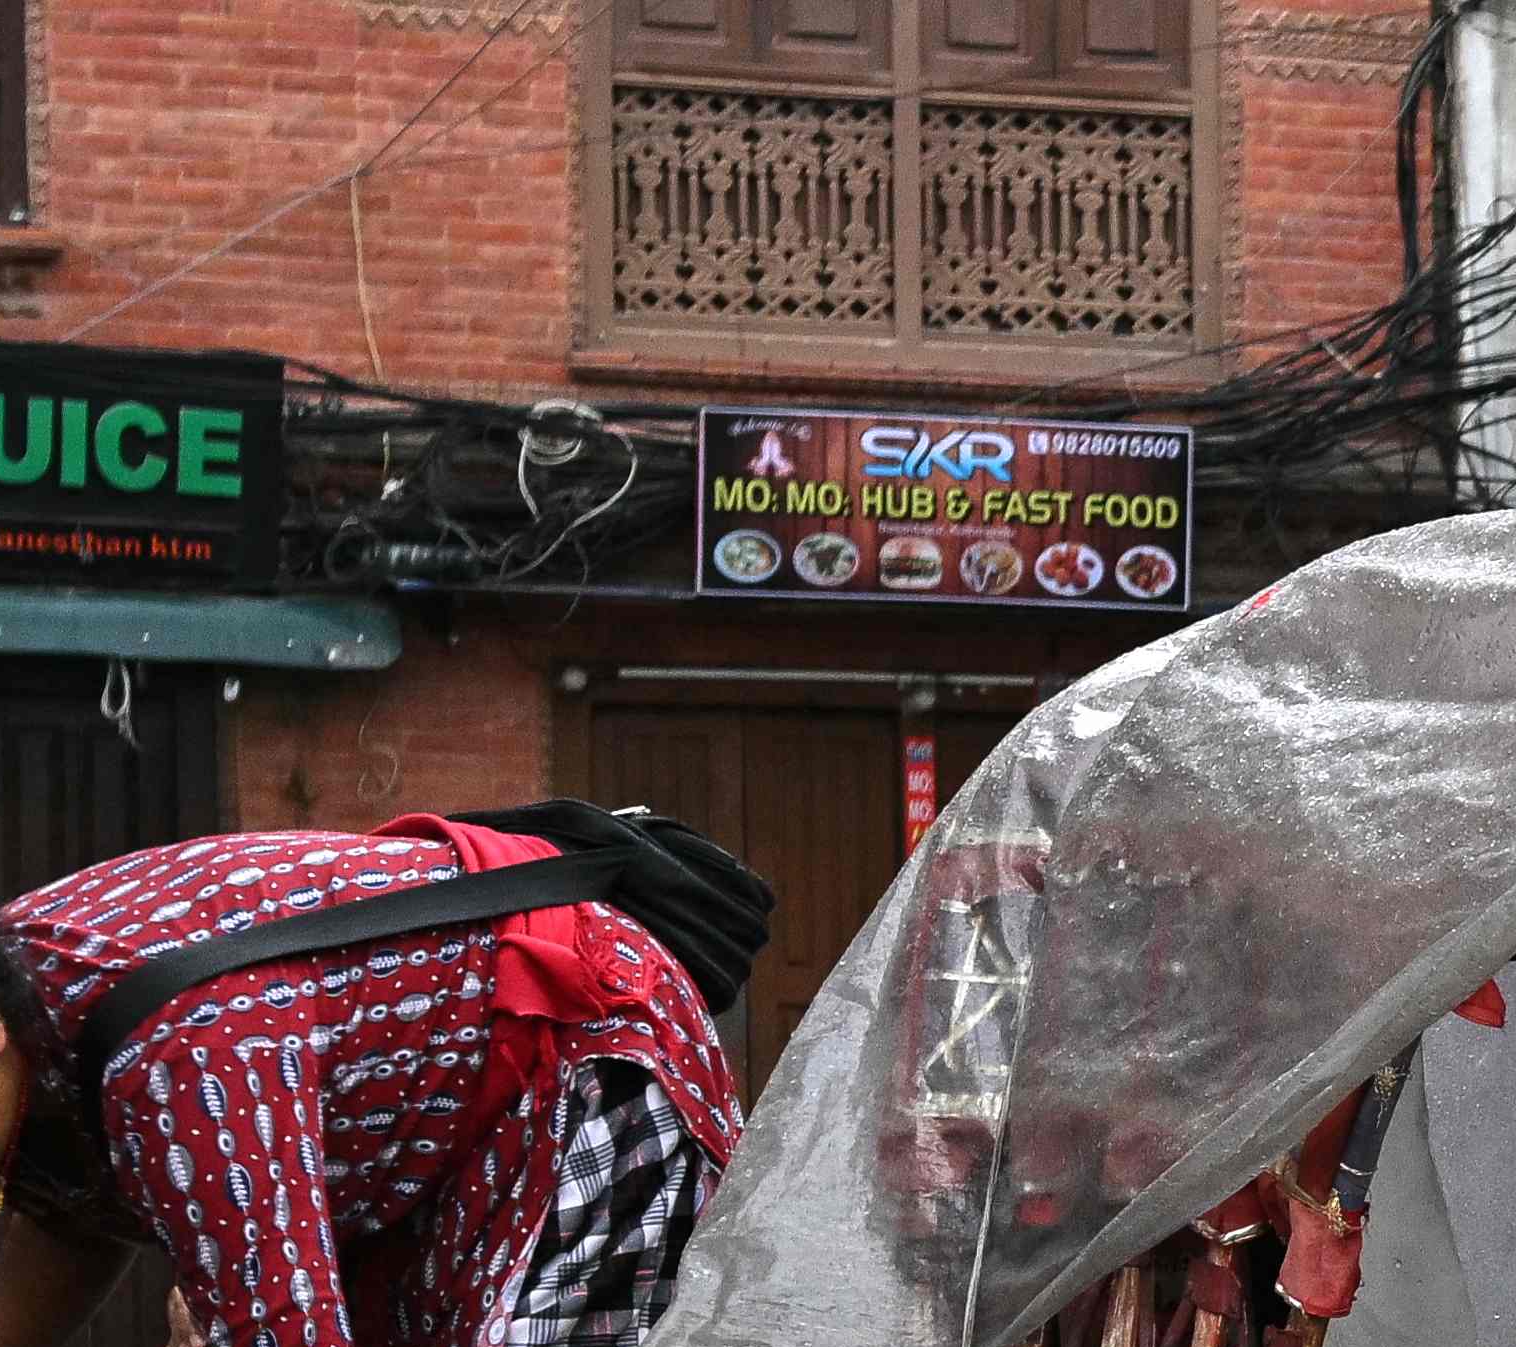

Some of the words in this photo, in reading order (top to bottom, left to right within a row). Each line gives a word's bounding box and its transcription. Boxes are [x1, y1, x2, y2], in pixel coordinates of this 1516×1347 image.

[859, 426, 1016, 482] SKR
[861, 483, 936, 520] HUB
[946, 486, 972, 522] &
[984, 489, 1074, 525] FAST
[1084, 492, 1180, 530] FOOD
